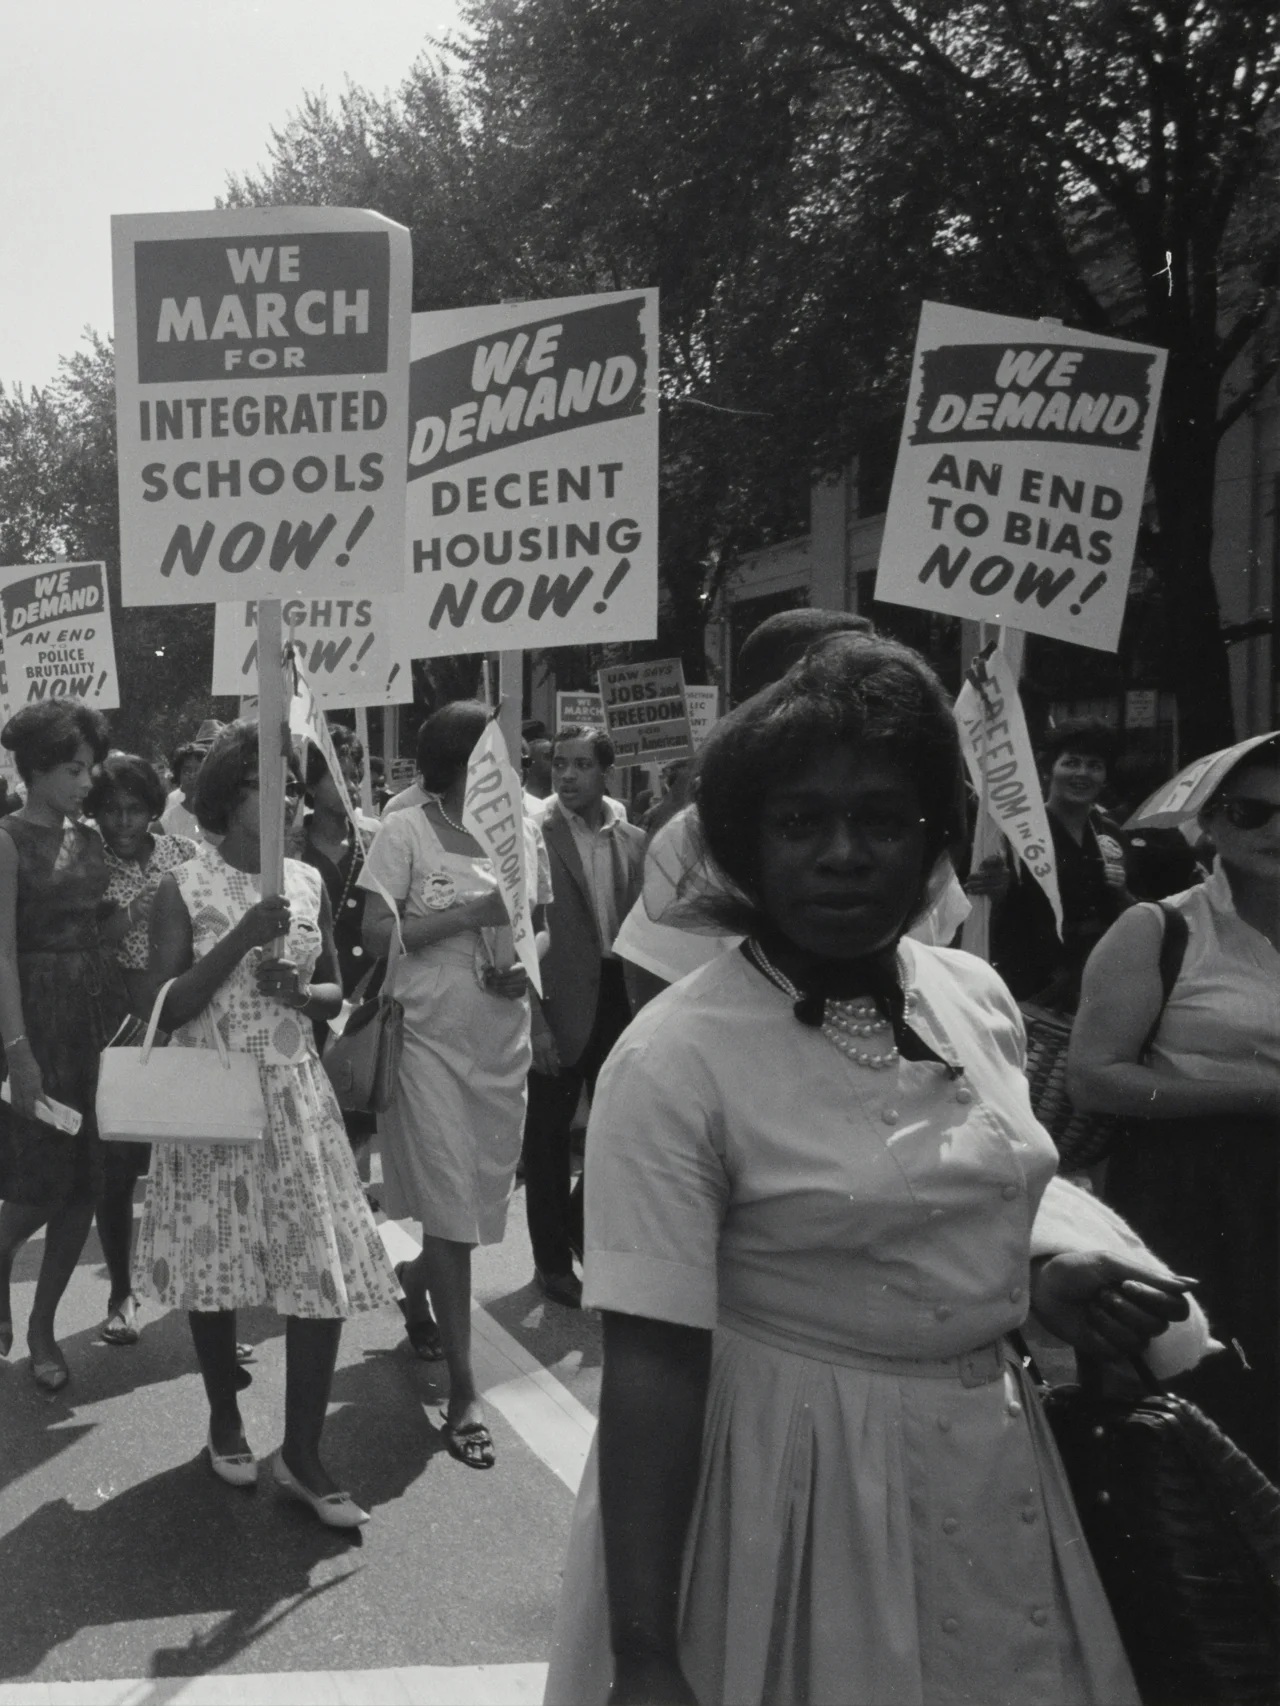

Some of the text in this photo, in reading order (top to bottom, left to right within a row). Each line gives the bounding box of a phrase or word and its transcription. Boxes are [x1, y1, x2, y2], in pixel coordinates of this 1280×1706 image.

[226, 245, 300, 284] WE
[156, 288, 371, 343] MARCH
[224, 346, 306, 371] FOR
[471, 323, 563, 392] WE
[995, 349, 1084, 388] WE
[139, 389, 388, 442] INTEGRATED
[408, 355, 638, 467] DEMAND
[927, 391, 1140, 435] DEMAND
[141, 452, 385, 502] SCHOOLS
[431, 462, 624, 517] DECENT
[927, 453, 1123, 521] AN END
[160, 504, 375, 578] NOW!
[413, 518, 642, 574] HOUSING
[927, 496, 1114, 566] TO BIAS
[34, 570, 71, 599] WE
[428, 557, 631, 631] NOW!
[918, 543, 1107, 616] NOW!
[11, 585, 100, 630] DEMAND
[244, 600, 373, 628] RGHTS
[20, 628, 96, 646] AN END
[38, 648, 85, 664] POLICE
[241, 632, 375, 675] W!
[25, 661, 95, 679] BRUTALITY
[27, 670, 107, 702] NOW!
[607, 670, 639, 684] UAW
[564, 706, 605, 716] MARCH
[607, 682, 657, 706] JOBS
[608, 701, 685, 728] FREEDOM
[985, 675, 1052, 878] FREEDOM IN '63
[466, 751, 521, 891] FREEDOM
